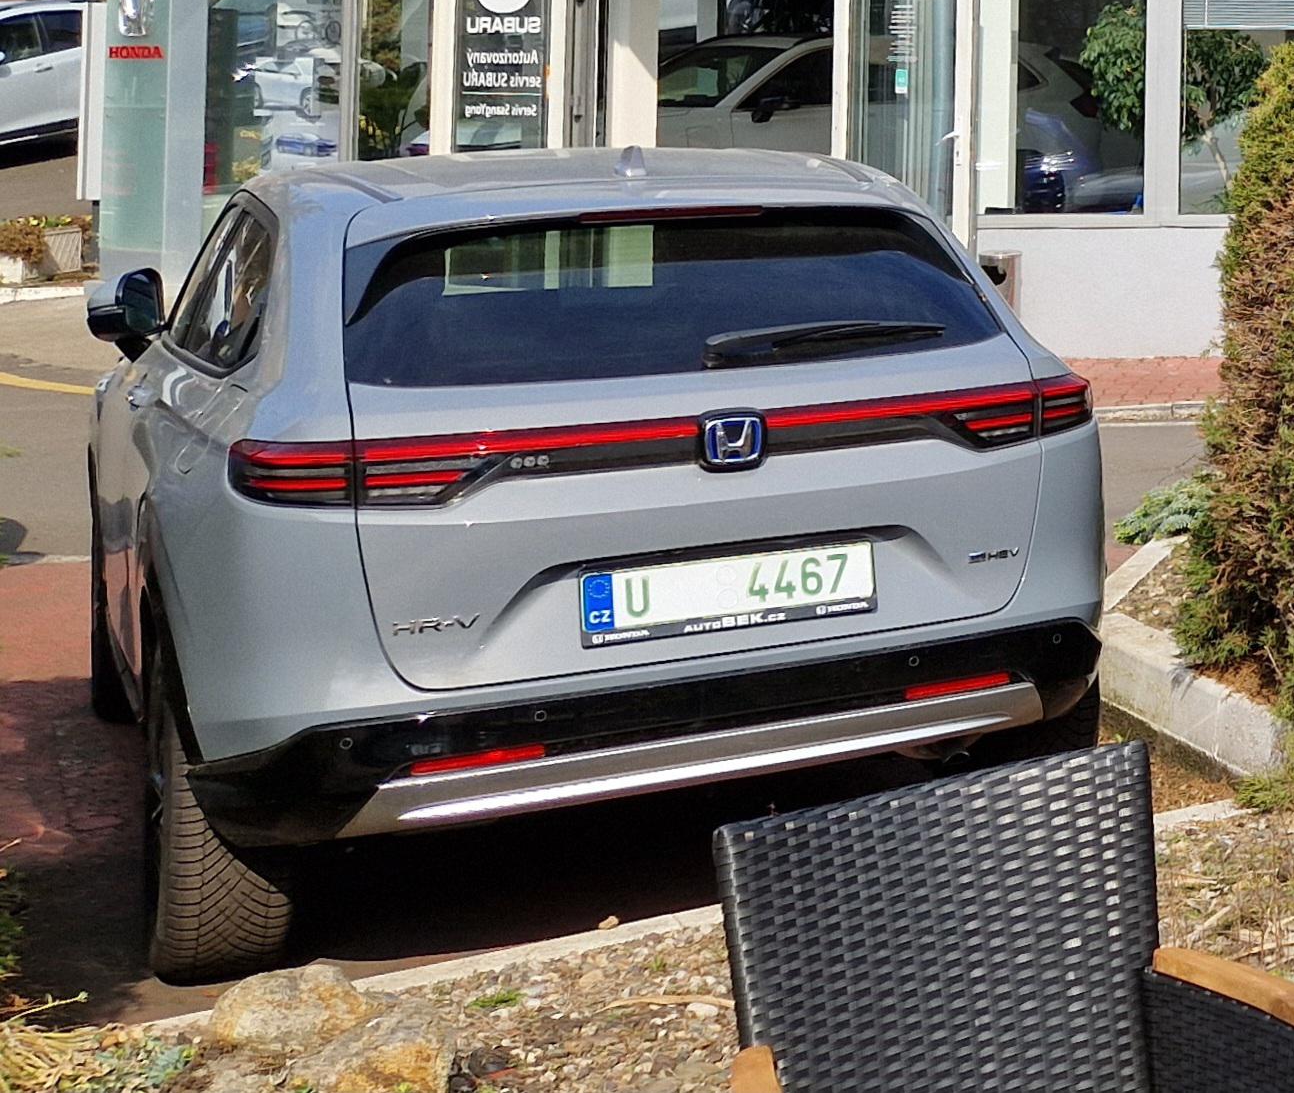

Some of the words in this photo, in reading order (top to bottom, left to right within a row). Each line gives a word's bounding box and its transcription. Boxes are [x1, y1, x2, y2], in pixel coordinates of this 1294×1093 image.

[109, 45, 164, 59] HONDA
[624, 577, 651, 618] U
[747, 554, 848, 603] 4467
[589, 610, 611, 624] CZ
